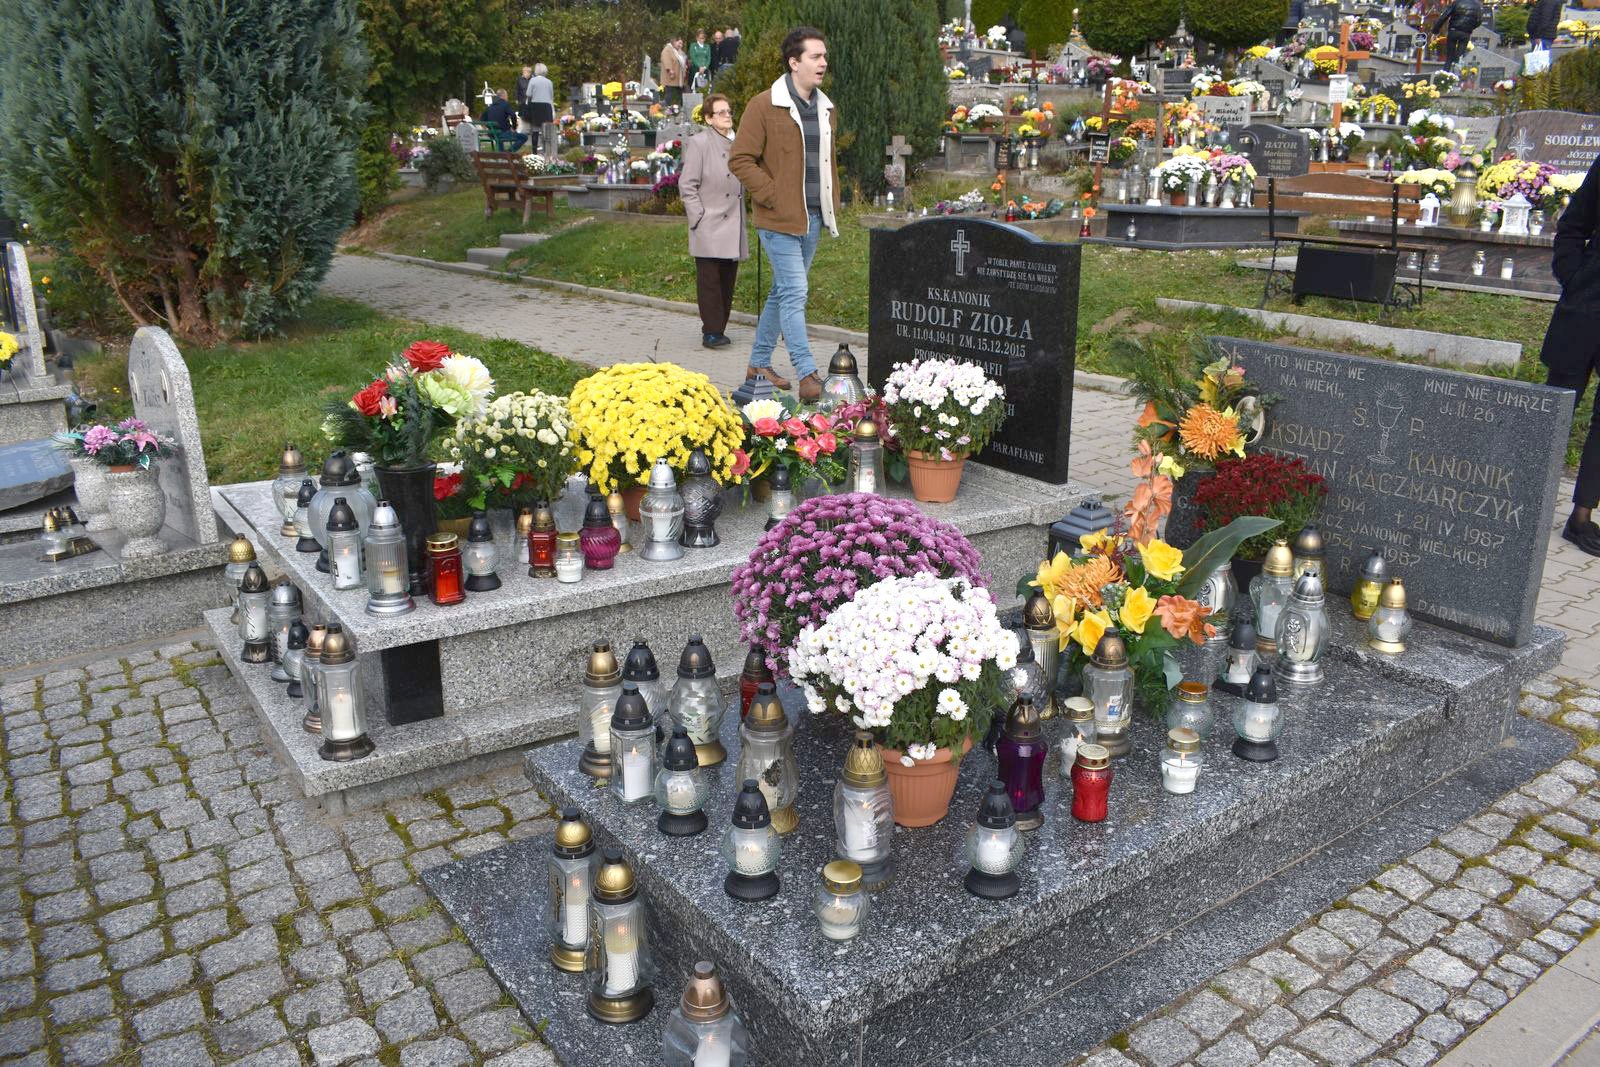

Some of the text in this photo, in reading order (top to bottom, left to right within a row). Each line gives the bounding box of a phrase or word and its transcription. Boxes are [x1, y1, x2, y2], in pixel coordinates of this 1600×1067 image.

[1264, 141, 1297, 150] BATOR
[928, 287, 991, 308] KS.KANONIK
[891, 300, 1034, 340] RUDOLF ZIOŁA
[896, 324, 1026, 358] UR. 11.04.1941 ZM. 15.12.2015
[1280, 374, 1298, 388] NA
[1474, 406, 1494, 423] 26
[1295, 357, 1342, 378] WIERZY
[1348, 366, 1366, 382] WE
[1424, 378, 1458, 397] MNIE
[1464, 386, 1490, 402] NIE
[1496, 391, 1552, 414] UMRZE
[993, 441, 1045, 465] PARAFIANIE
[1408, 448, 1515, 498] KANONIK
[1348, 464, 1524, 530] KACZMARCZYK
[1337, 495, 1366, 515] 1914
[1438, 519, 1455, 536] IV
[1464, 524, 1505, 549] 1987
[1350, 520, 1412, 547] JANOWIC
[1419, 538, 1488, 568] WIELKICH
[1384, 545, 1422, 567] 1987
[1416, 600, 1510, 638] PARAFIANIE
